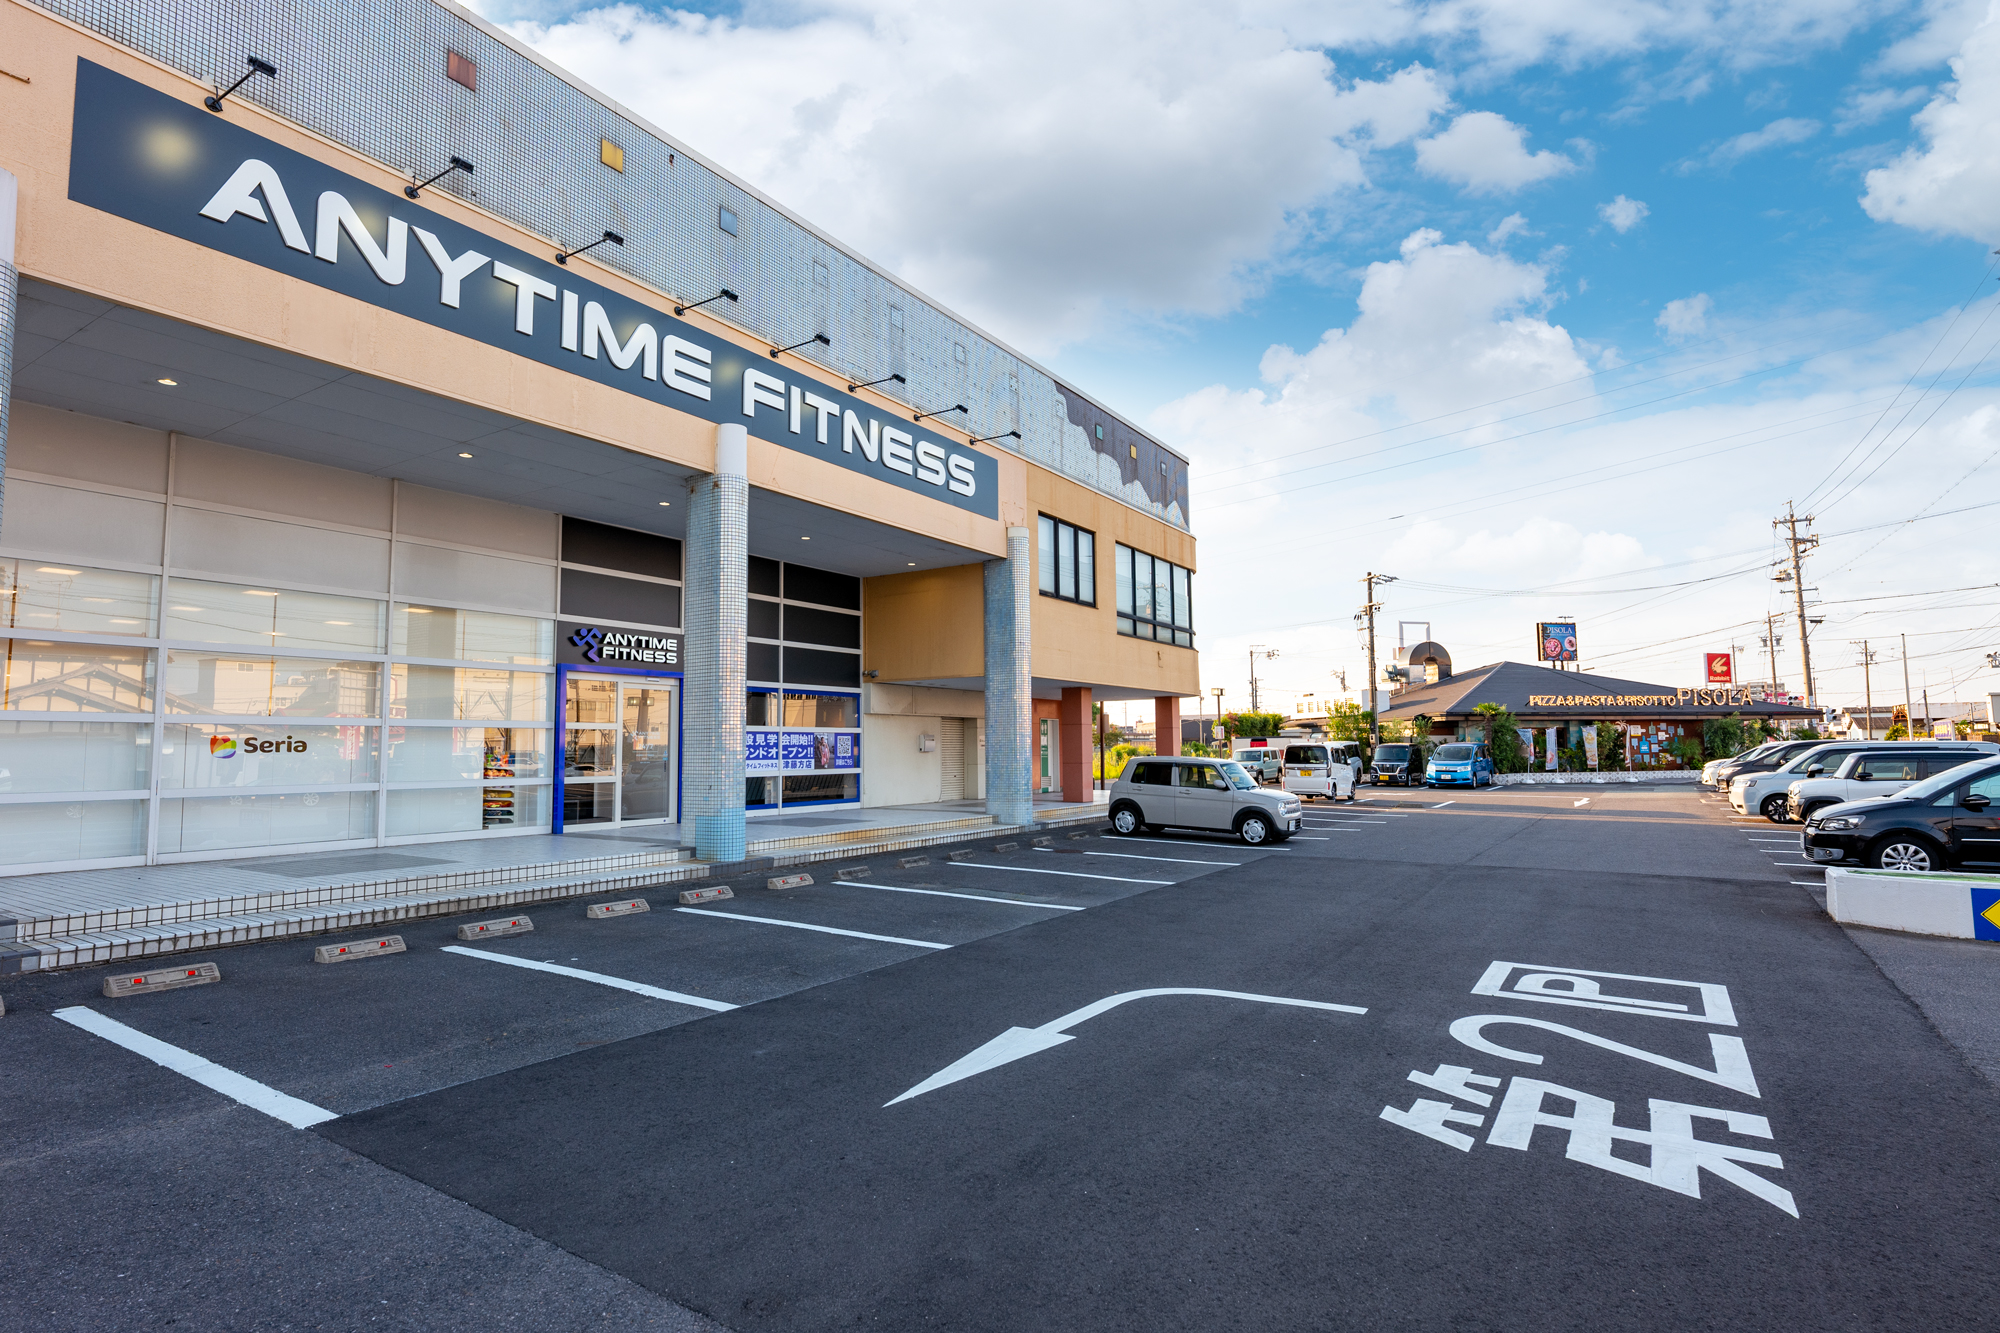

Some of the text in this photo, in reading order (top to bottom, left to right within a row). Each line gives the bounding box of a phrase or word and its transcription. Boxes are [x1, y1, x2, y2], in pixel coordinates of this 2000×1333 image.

[199, 158, 976, 497] ANYTIME FITNESS
[603, 632, 678, 651] ANYTIME
[602, 646, 678, 664] FITNESS
[1677, 688, 1754, 706] PISOLA
[244, 735, 308, 753] Seria
